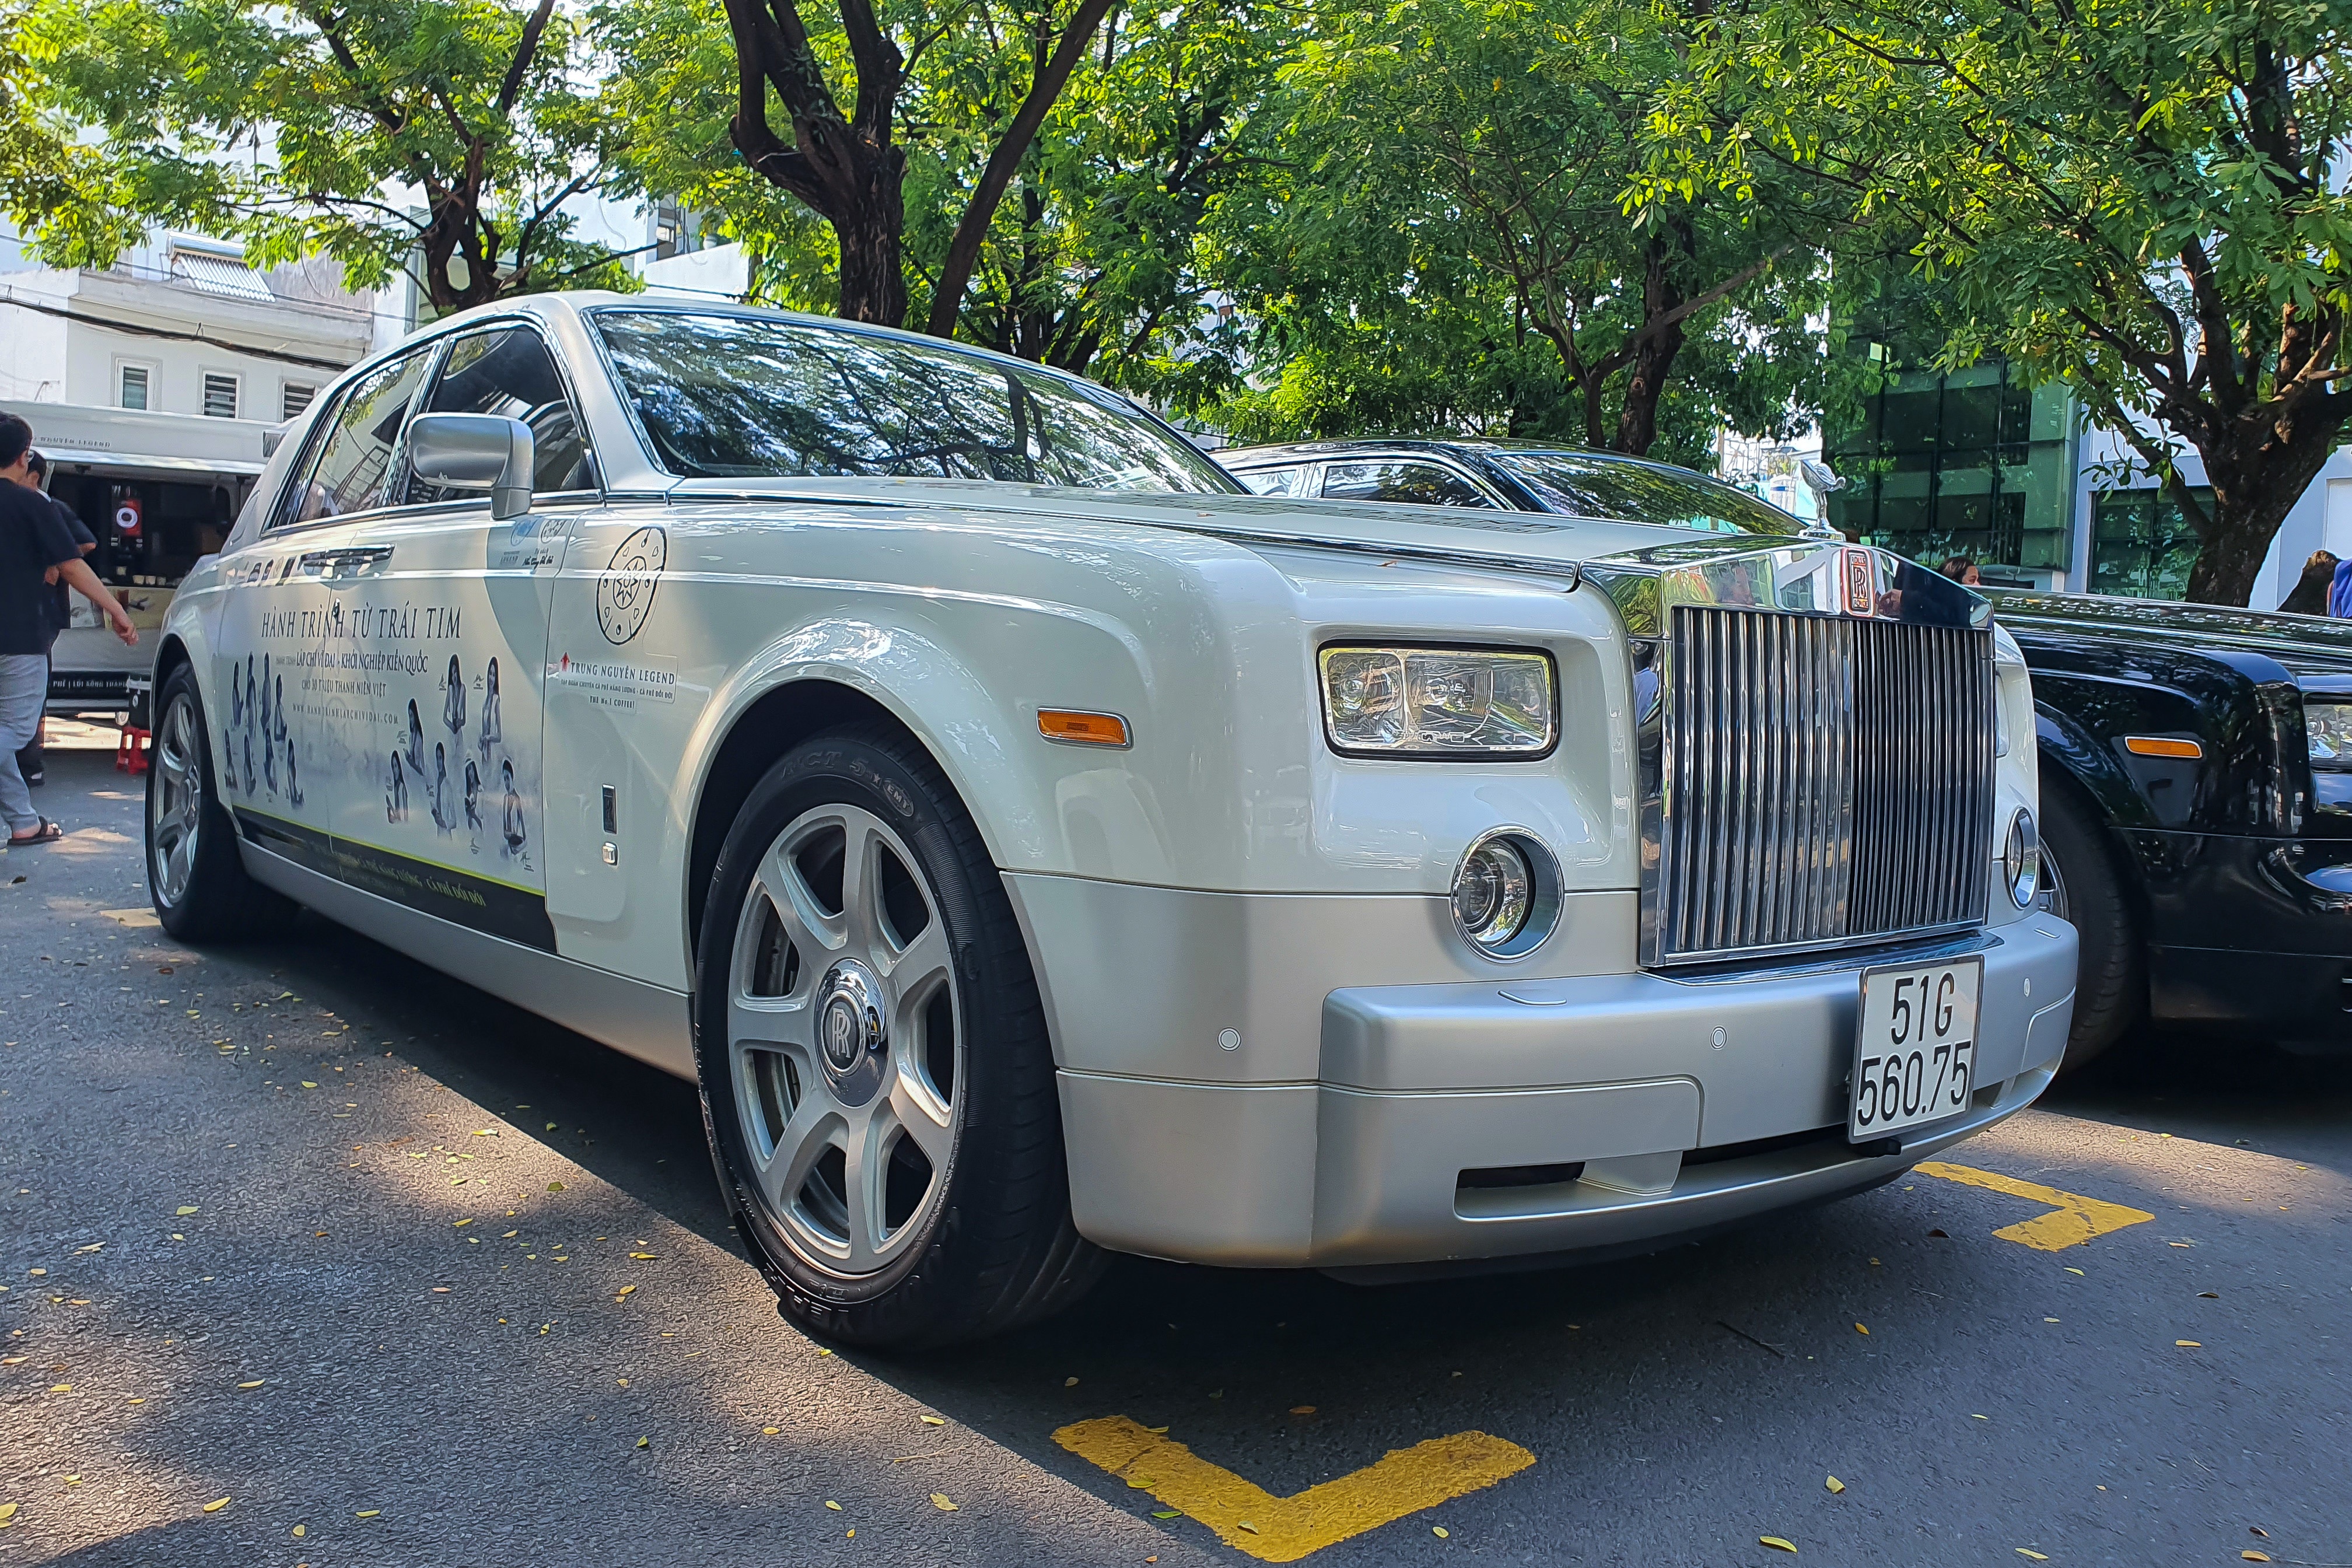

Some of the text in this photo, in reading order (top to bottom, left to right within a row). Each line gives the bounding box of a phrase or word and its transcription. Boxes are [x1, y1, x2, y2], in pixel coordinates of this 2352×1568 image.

[1852, 556, 1866, 564] ROLLS
[261, 600, 461, 639] HÀNH TRÌNH TỪ TRÁI TIM
[341, 648, 359, 670] KHỞI
[359, 650, 386, 673] NGHIỆP
[405, 648, 429, 676] QUỐC
[570, 662, 675, 685] TRUNG NGUYÊN LEGEND
[887, 784, 911, 809] EMT
[1891, 972, 1955, 1045] 51G
[1857, 1040, 1972, 1127] 560.75
